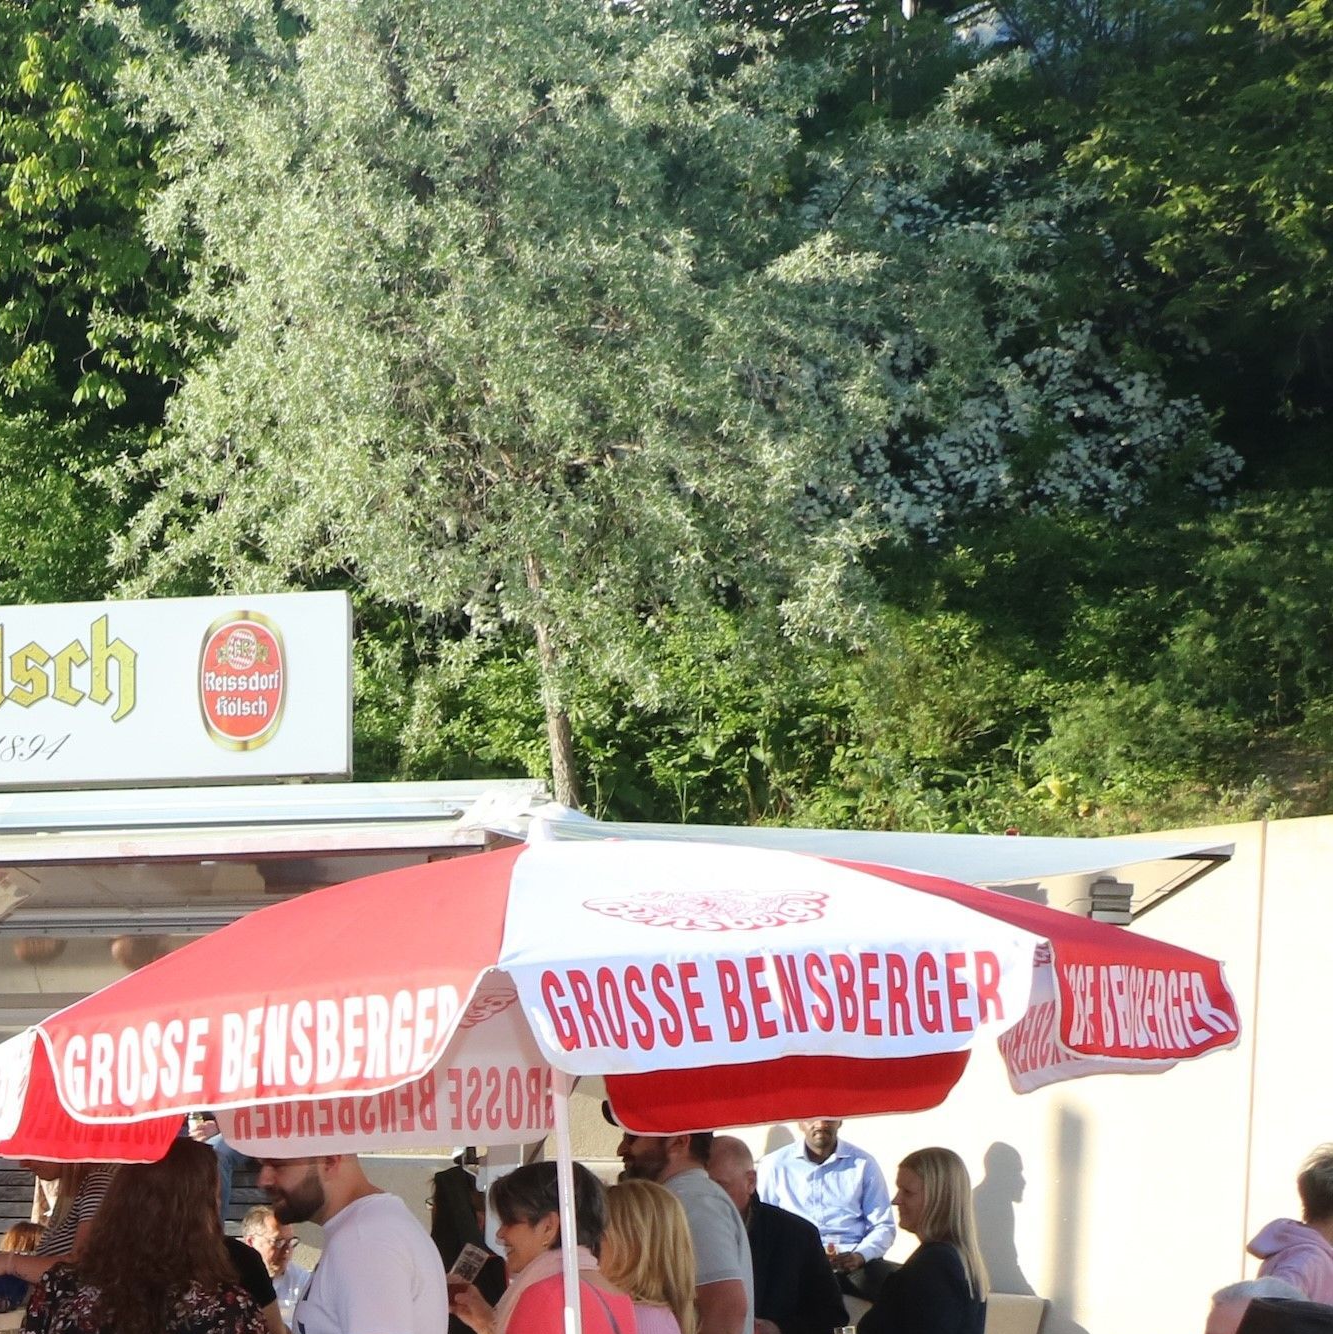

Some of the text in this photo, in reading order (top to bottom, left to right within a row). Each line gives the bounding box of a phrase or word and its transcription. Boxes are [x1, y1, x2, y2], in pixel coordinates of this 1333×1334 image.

[204, 669, 280, 692] Reissdorf
[215, 695, 268, 718] Kölsch
[540, 961, 713, 1052] GROSSE
[714, 950, 1006, 1043] BENSBERGER
[64, 1017, 209, 1110] GROSSE
